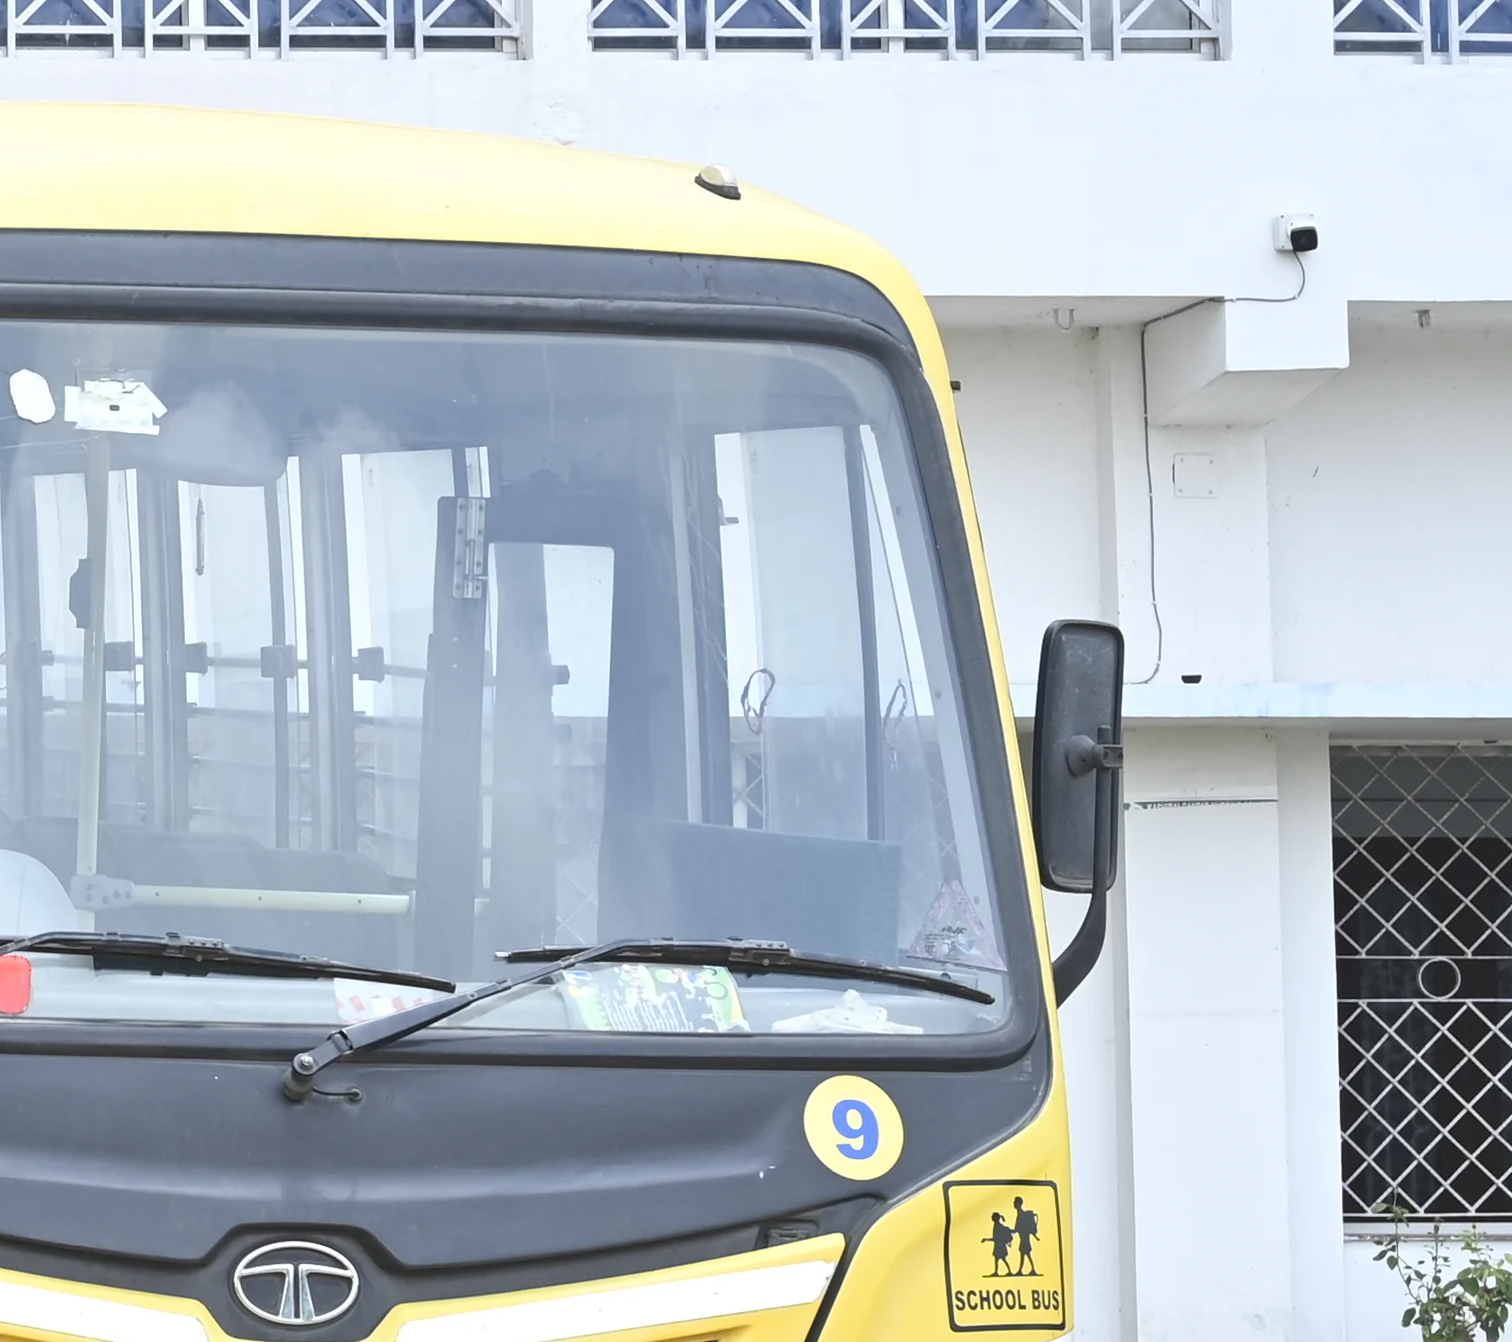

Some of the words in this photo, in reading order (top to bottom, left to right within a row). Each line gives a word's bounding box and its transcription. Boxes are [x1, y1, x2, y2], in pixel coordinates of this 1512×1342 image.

[832, 1099, 880, 1160] 9
[954, 1289, 1026, 1311] SCHOOL
[1031, 1289, 1060, 1311] BUS
